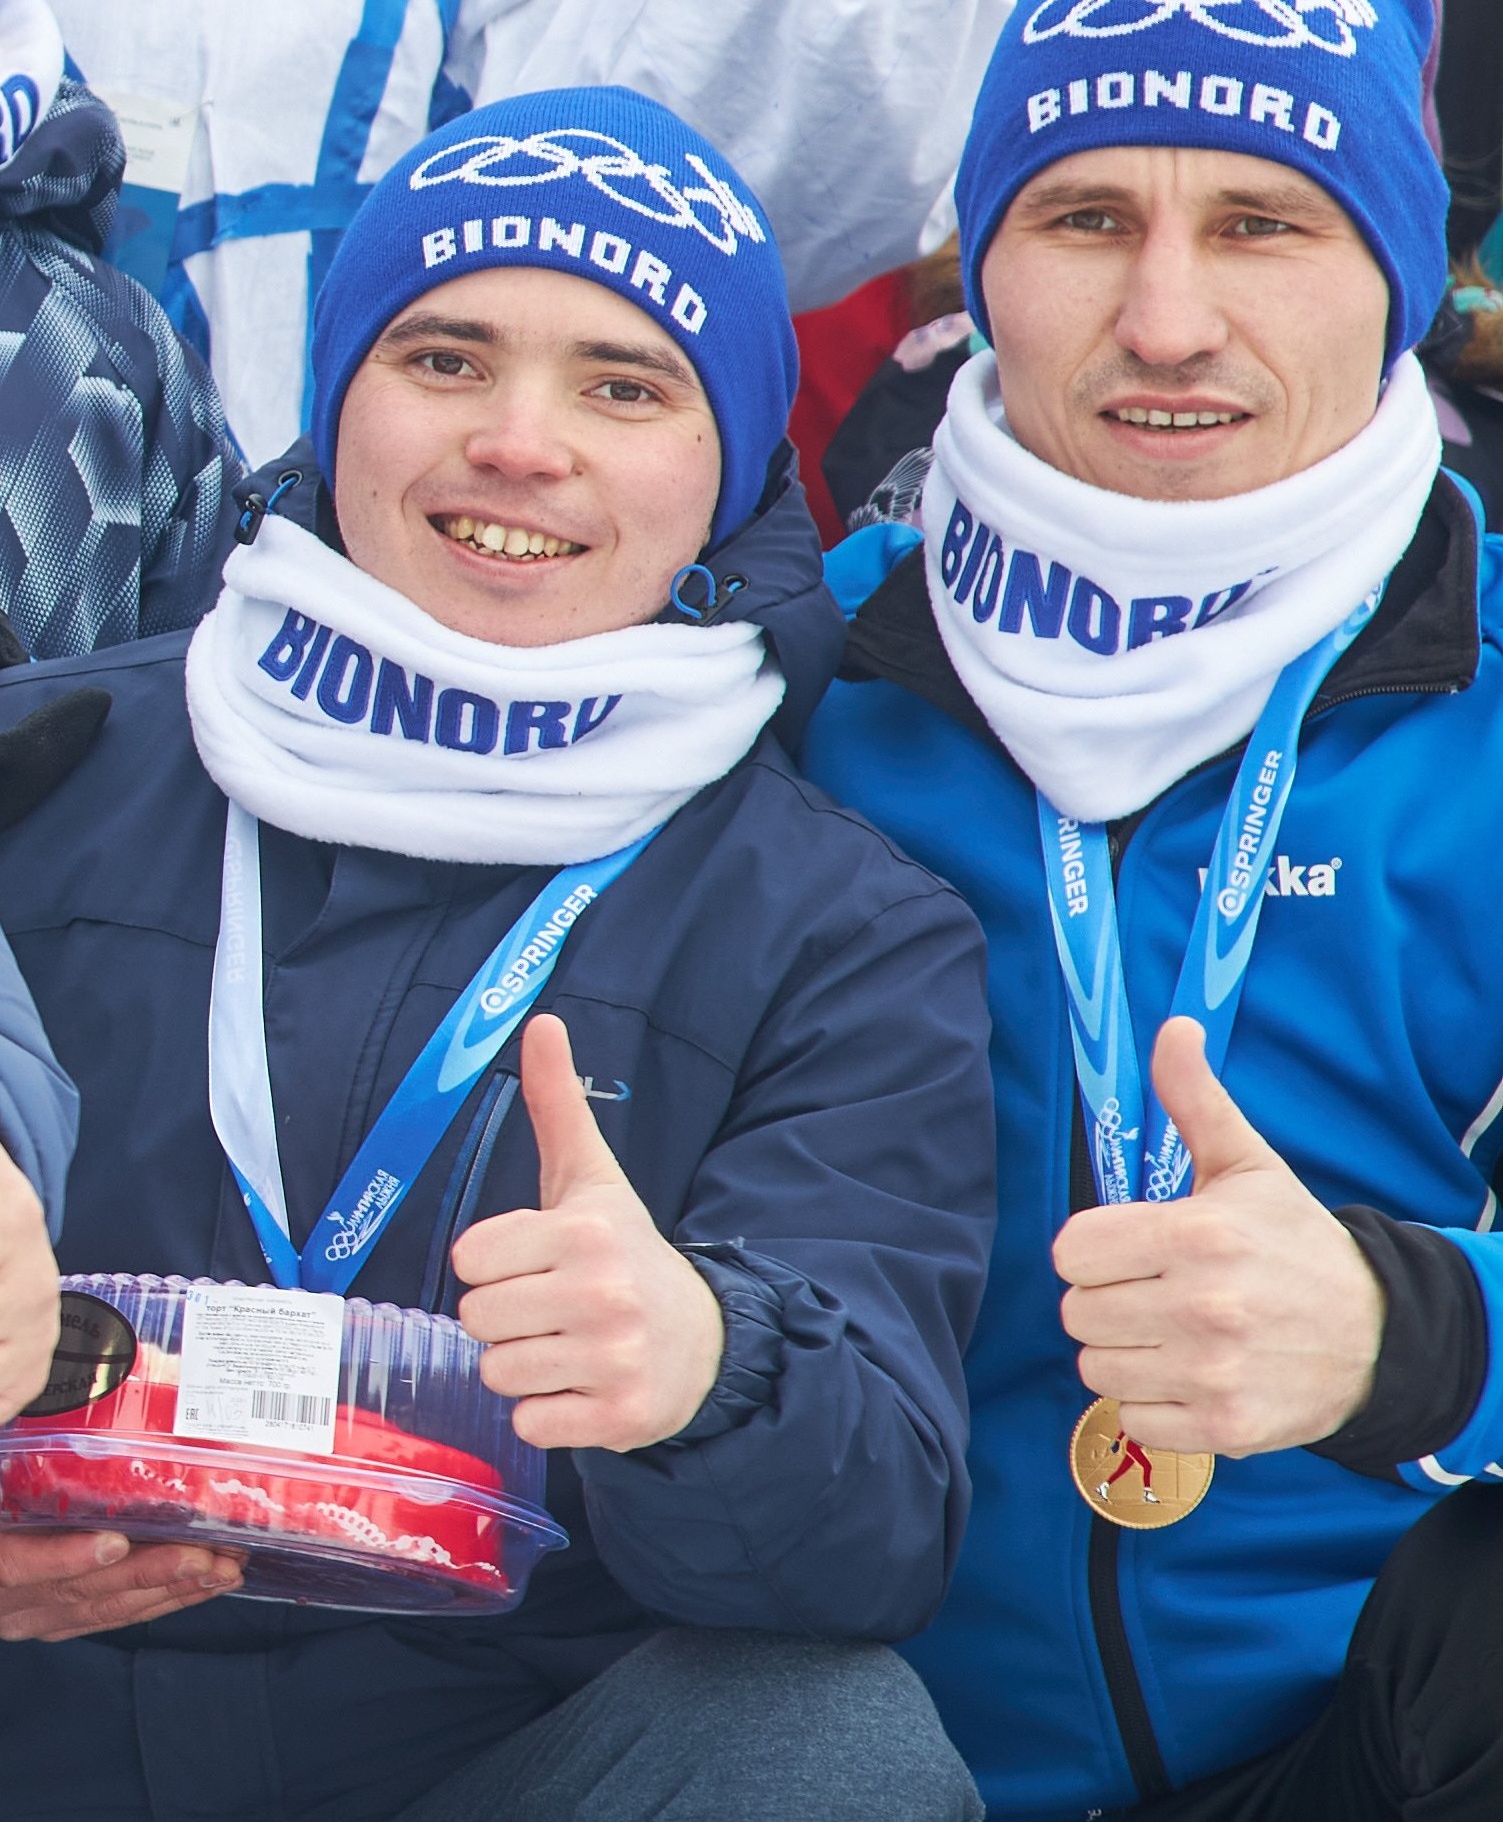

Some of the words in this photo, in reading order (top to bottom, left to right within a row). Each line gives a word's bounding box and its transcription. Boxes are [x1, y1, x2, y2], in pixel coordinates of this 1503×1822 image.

[1026, 69, 1341, 152] BIONORD
[421, 214, 708, 336] BIONORD
[206, 1305, 227, 1314] торт
